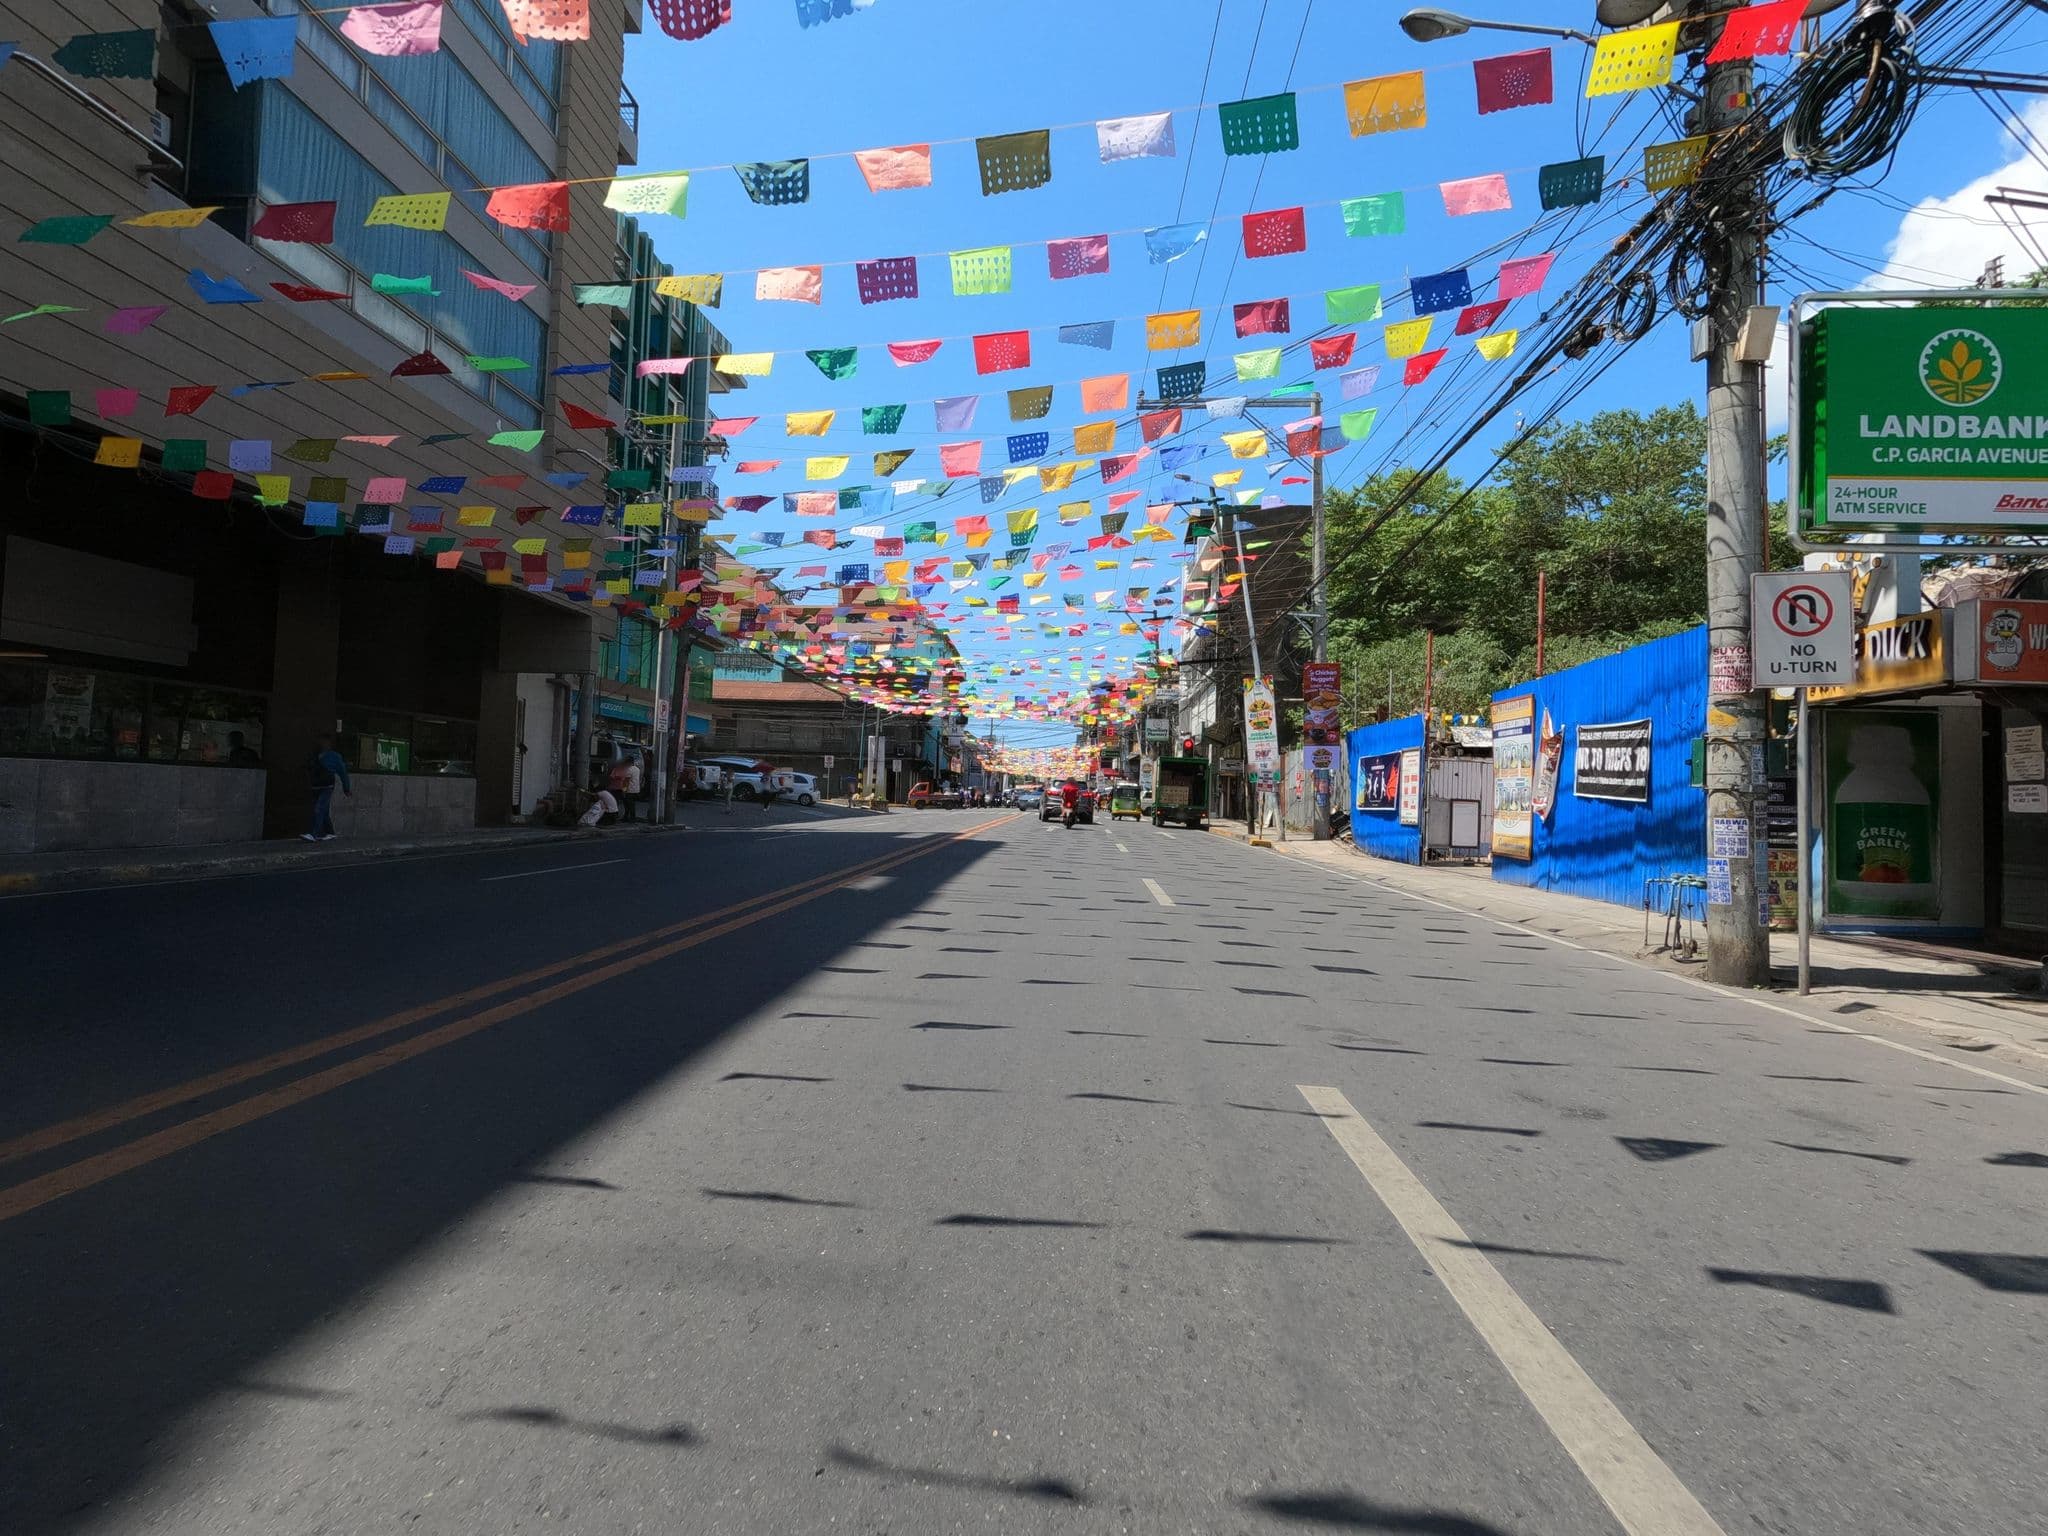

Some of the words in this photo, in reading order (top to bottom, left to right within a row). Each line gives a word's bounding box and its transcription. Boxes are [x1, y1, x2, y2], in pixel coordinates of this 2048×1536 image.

[1860, 415, 2048, 438] LANDBANK
[1872, 447, 1903, 463] C.P.
[1907, 448, 1973, 464] GARCIA
[1976, 448, 2048, 464] AVENUE
[1834, 487, 1898, 499] 24-HOUR
[1995, 494, 2048, 508] Banc
[1835, 502, 1865, 514] ATM
[1868, 502, 1927, 515] SERVICE
[1864, 619, 1928, 662] DUCK
[1790, 644, 1816, 657] NO
[1770, 661, 1837, 674] U-TURN
[1860, 826, 1907, 839] GREEN
[1857, 838, 1911, 852] BARLEY
